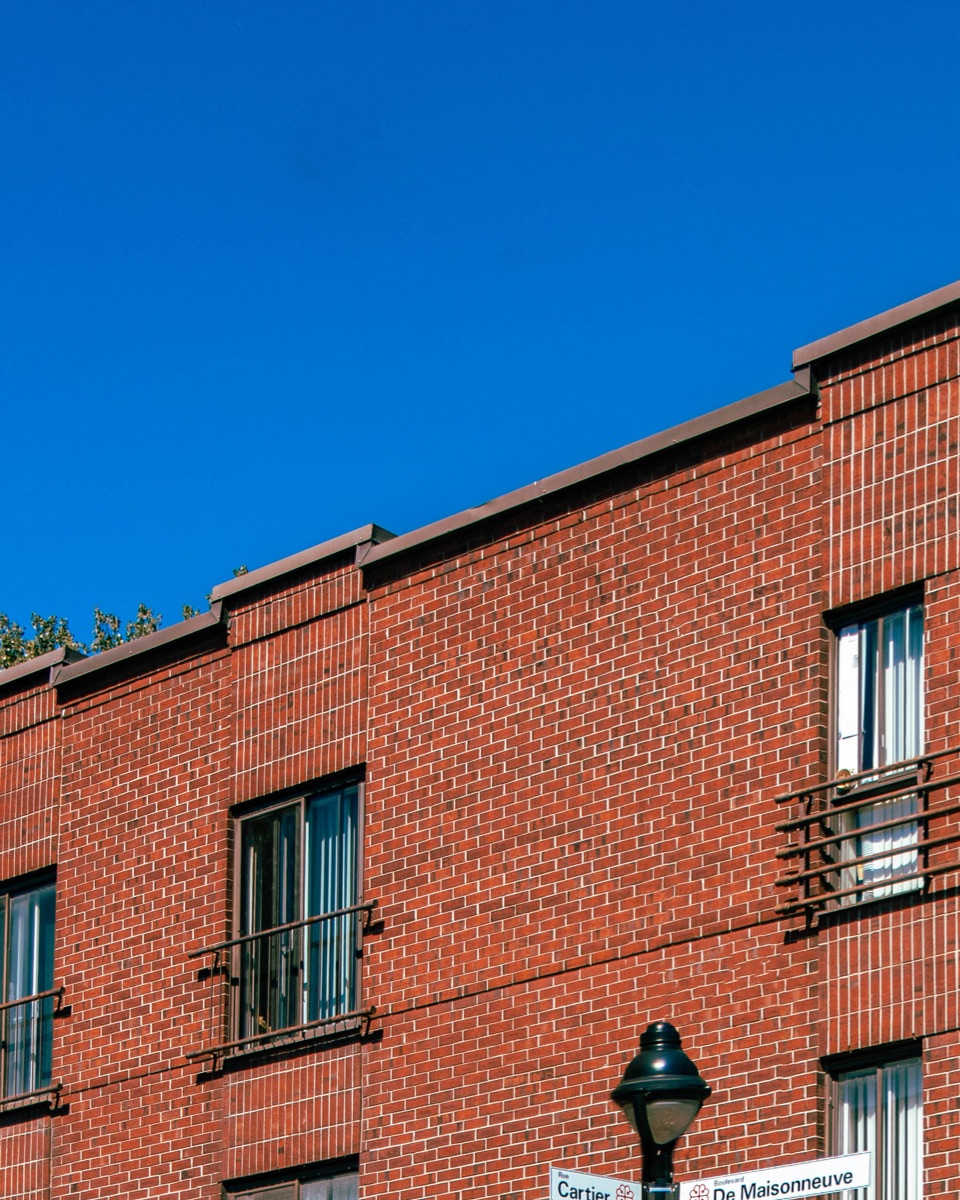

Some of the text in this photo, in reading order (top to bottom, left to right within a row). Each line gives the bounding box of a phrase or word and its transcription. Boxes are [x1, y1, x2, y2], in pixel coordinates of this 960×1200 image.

[558, 1172, 570, 1180] Rue
[713, 1176, 745, 1187] Boulevard
[740, 1171, 854, 1200] Maisonneuve
